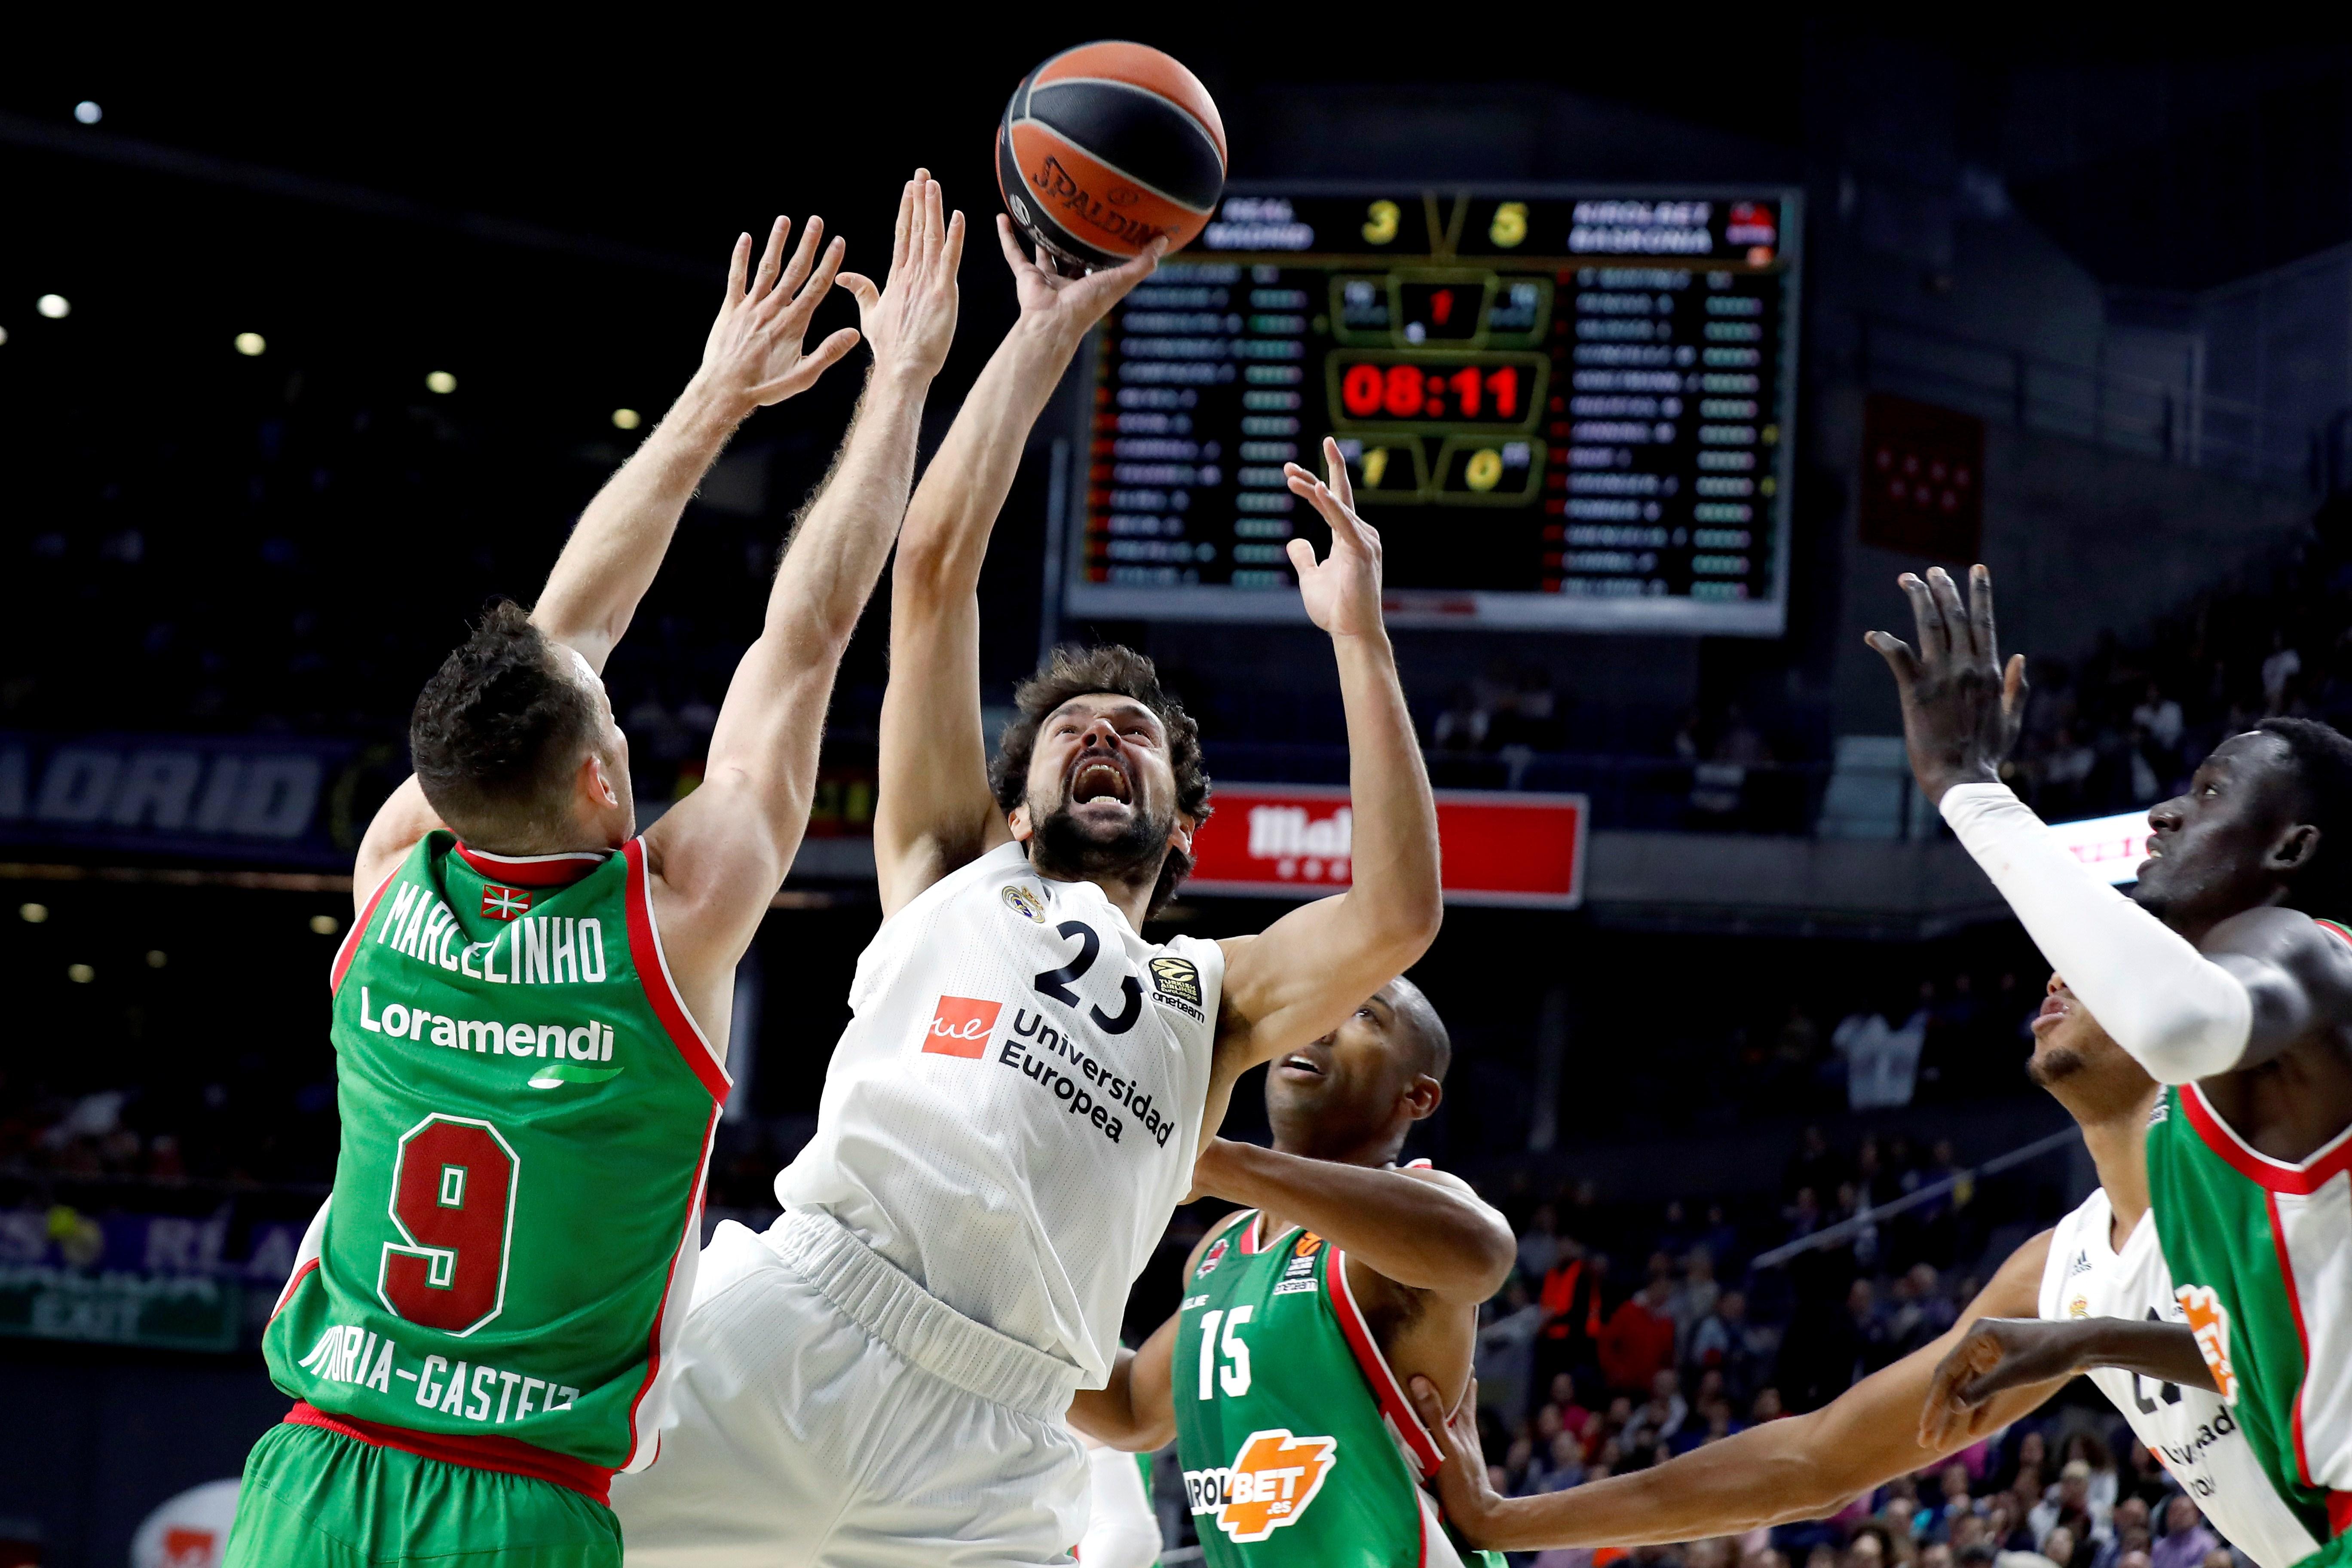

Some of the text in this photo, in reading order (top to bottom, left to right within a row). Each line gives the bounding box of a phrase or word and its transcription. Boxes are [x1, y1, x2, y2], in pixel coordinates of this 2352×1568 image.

[1032, 155, 1181, 248] SPALDIN
[1361, 199, 1401, 246] 3
[1489, 201, 1528, 248] 5
[1430, 289, 1454, 326] 1
[1342, 364, 1518, 419] 08:11
[1152, 992, 1204, 1024] oneteam
[1159, 979, 1196, 990] TURKISH
[1161, 983, 1197, 996] AIRLINES
[360, 986, 614, 1061] Loramendi
[998, 1040, 1124, 1143] Europea
[1013, 1009, 1174, 1148] Universidad
[377, 1112, 521, 1338] 9
[1199, 1305, 1254, 1400] 15
